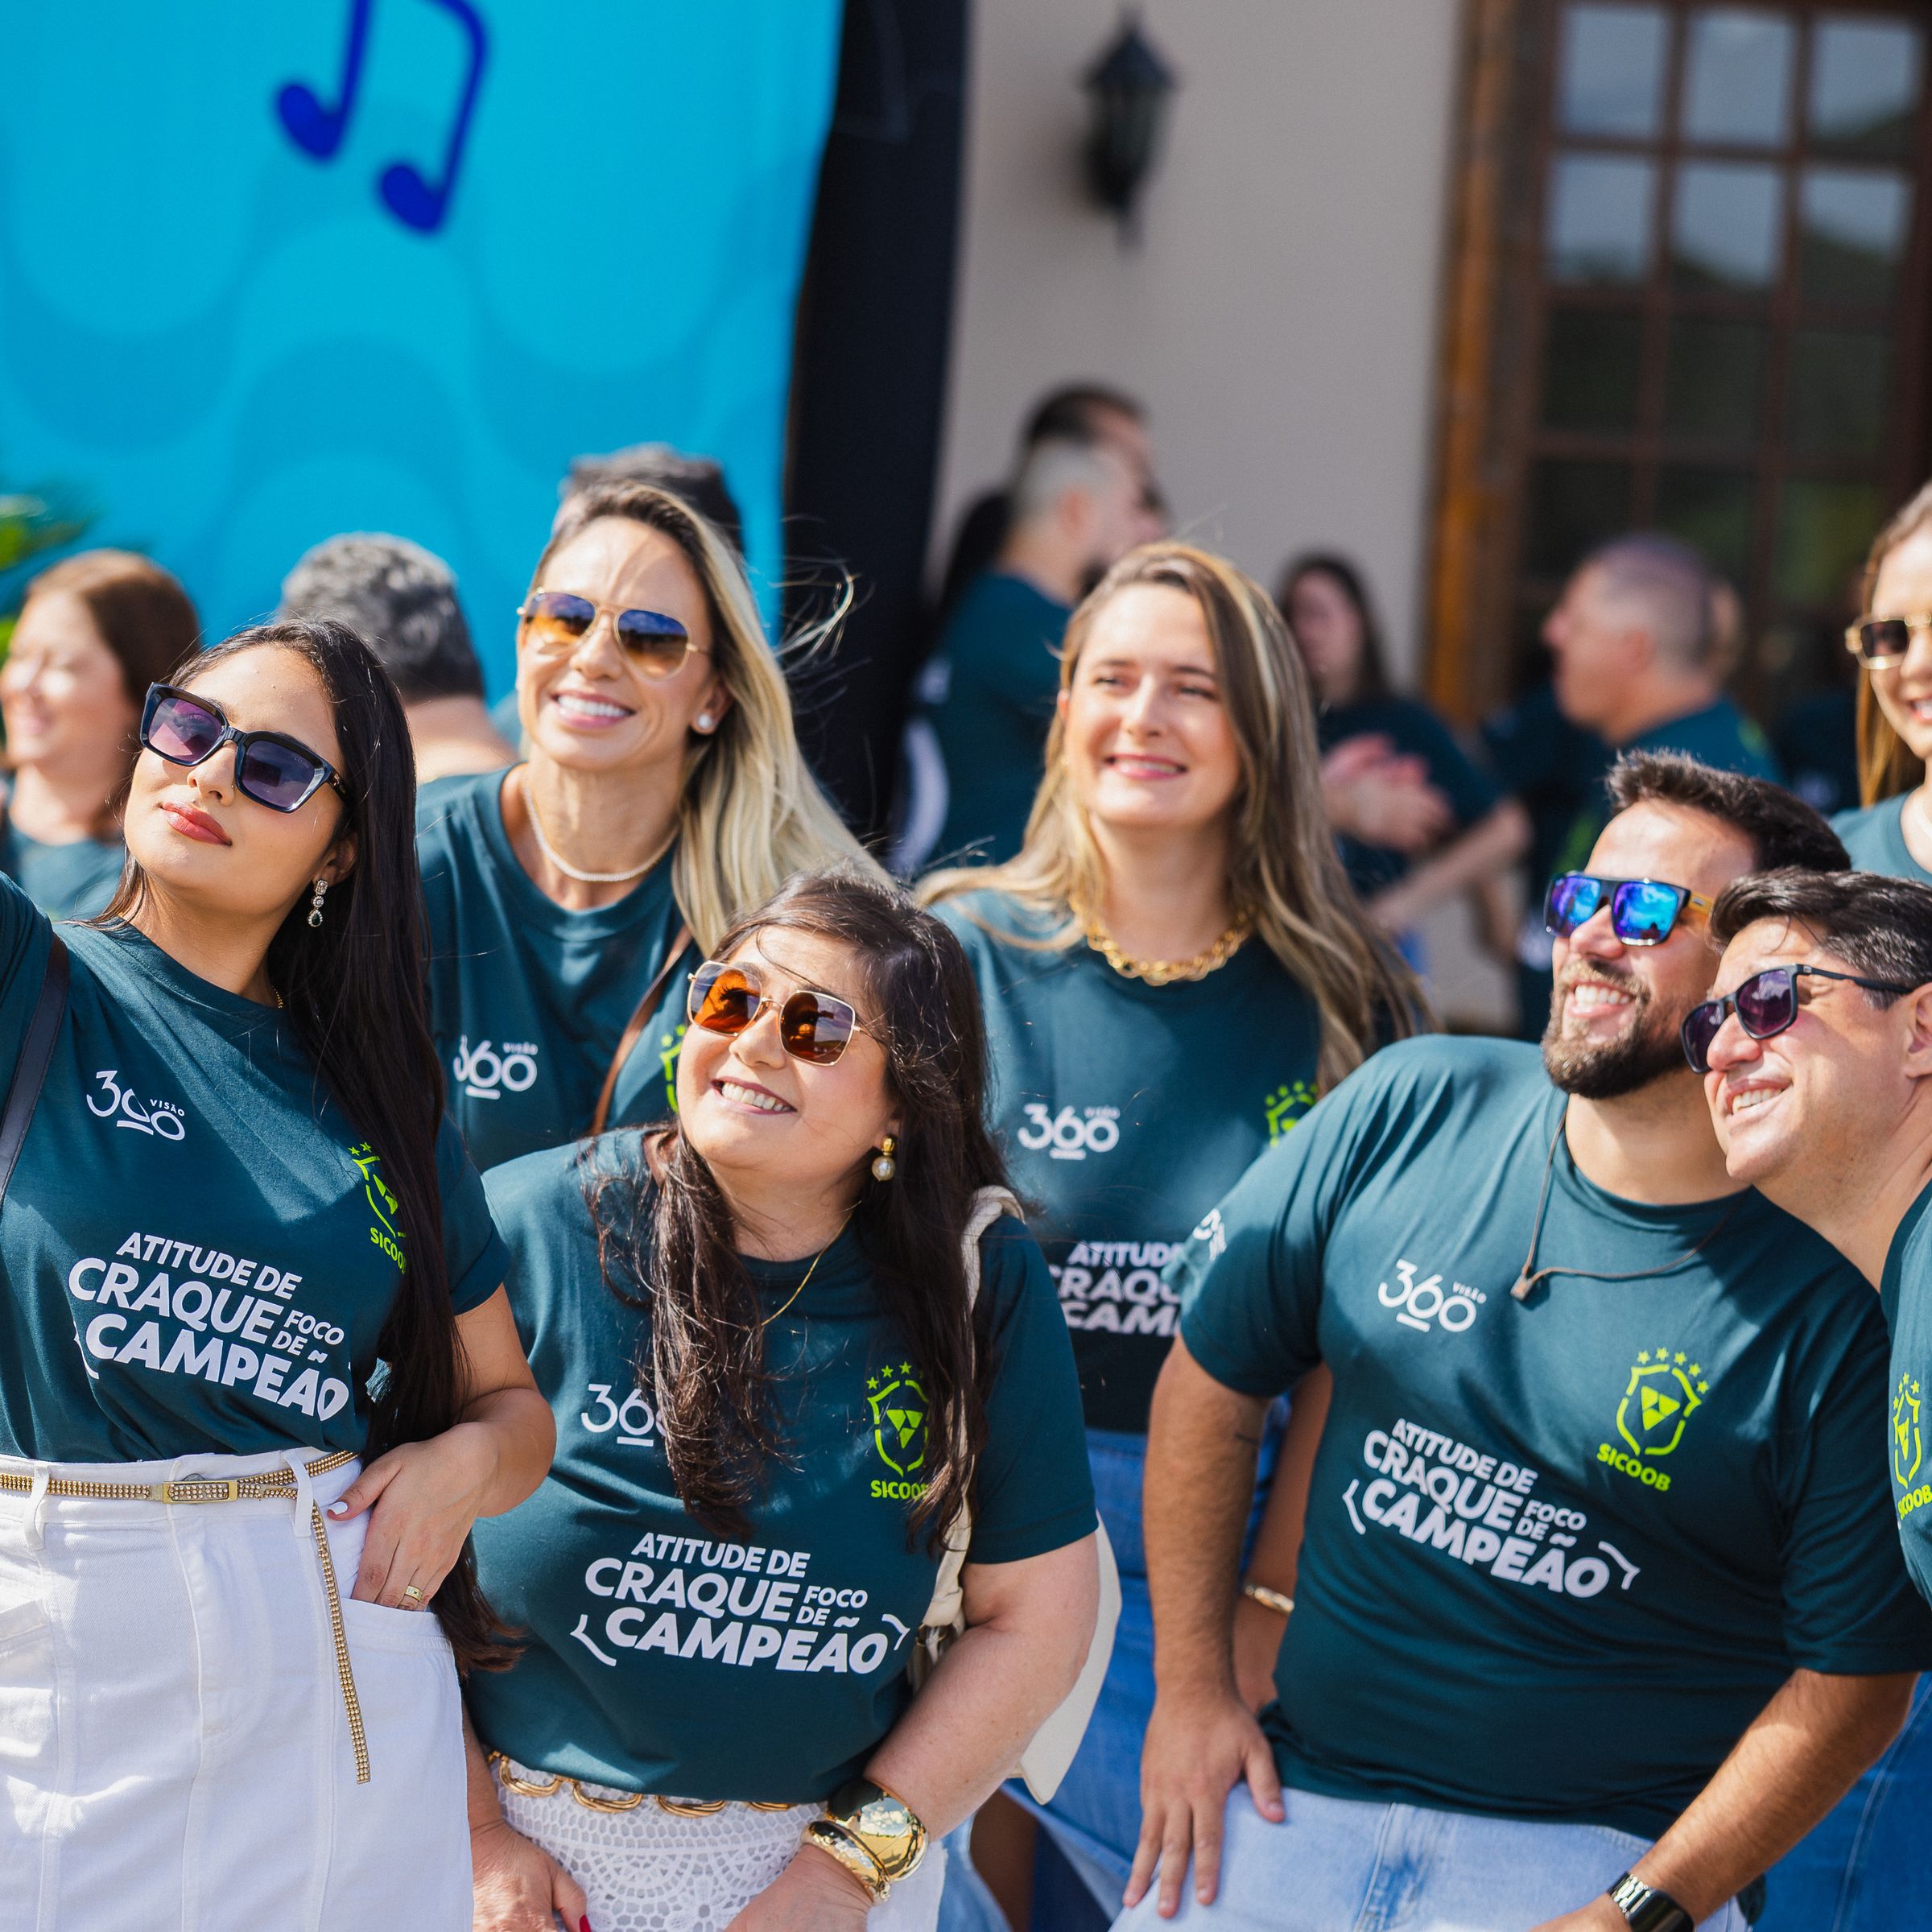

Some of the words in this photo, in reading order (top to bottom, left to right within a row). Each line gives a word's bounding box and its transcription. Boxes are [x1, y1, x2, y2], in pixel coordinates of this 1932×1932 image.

[150, 1099, 185, 1117] VISÃO
[1018, 1103, 1120, 1153] 360
[116, 1232, 257, 1286] ATITUDE
[254, 1265, 303, 1300] DE
[370, 1227, 407, 1275] SICOO
[68, 1257, 283, 1344] CRAQUE
[1060, 1302, 1181, 1337] CAM
[1378, 1258, 1476, 1332] 360
[272, 1331, 308, 1356] DE
[283, 1310, 345, 1345] FOCO
[86, 1313, 349, 1421] CAMPEÃO
[581, 1384, 668, 1438] 36
[1364, 1430, 1523, 1530] CRAQUE
[1392, 1418, 1497, 1480] ATITUDE
[1493, 1461, 1538, 1494] DE
[1596, 1443, 1671, 1492] SICOOB
[1362, 1478, 1610, 1598] CAMPEÃO
[1515, 1517, 1549, 1541] DE
[1523, 1500, 1587, 1530] FOCO
[631, 1533, 766, 1574] ATITUDE
[766, 1550, 810, 1578] DE
[585, 1558, 800, 1622] CRAQUE
[803, 1586, 868, 1608] FOCO
[605, 1607, 888, 1674] CAMPEÃO
[796, 1606, 830, 1627] DE
